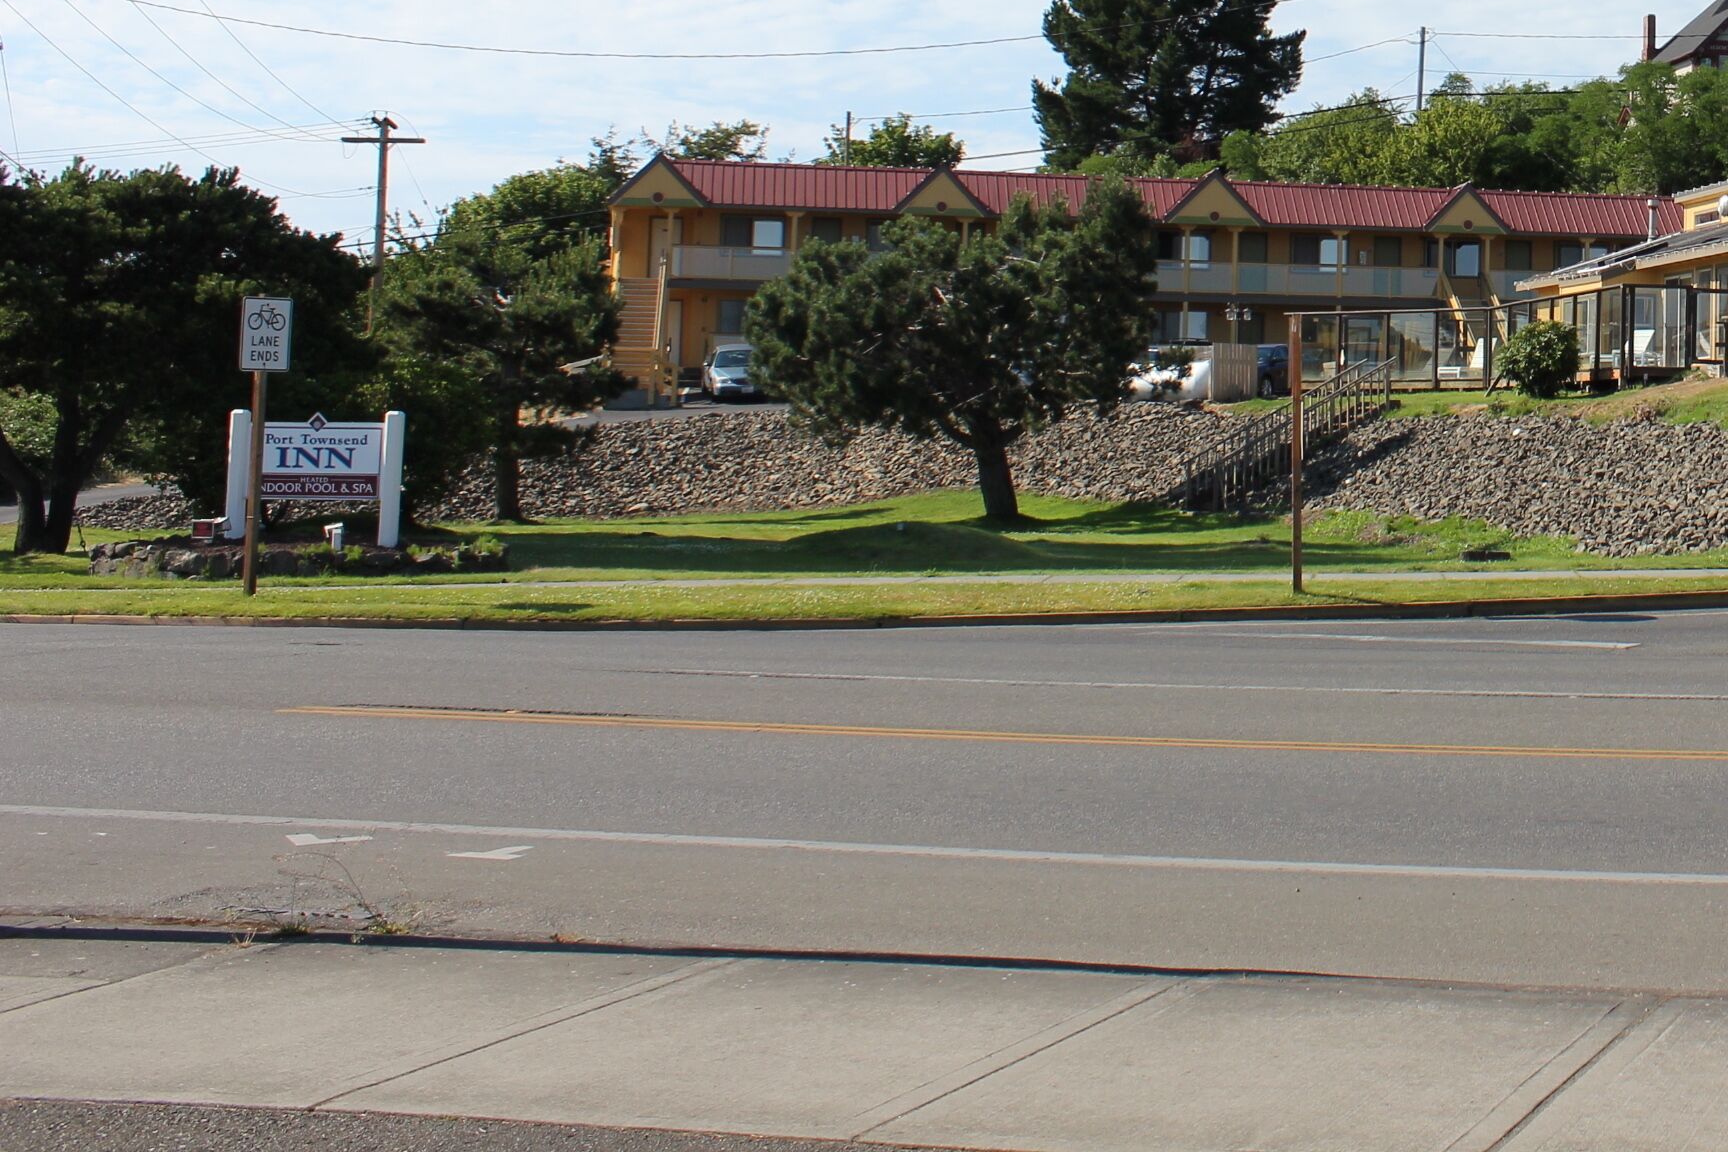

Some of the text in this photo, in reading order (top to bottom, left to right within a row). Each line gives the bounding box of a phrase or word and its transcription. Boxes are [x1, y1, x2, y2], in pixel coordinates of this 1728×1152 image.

[251, 336, 280, 347] LANE
[250, 350, 279, 362] ENDS
[265, 433, 368, 446] Port Townsend
[276, 447, 356, 468] INN
[261, 482, 373, 494] NDOOR POOL & SPA
